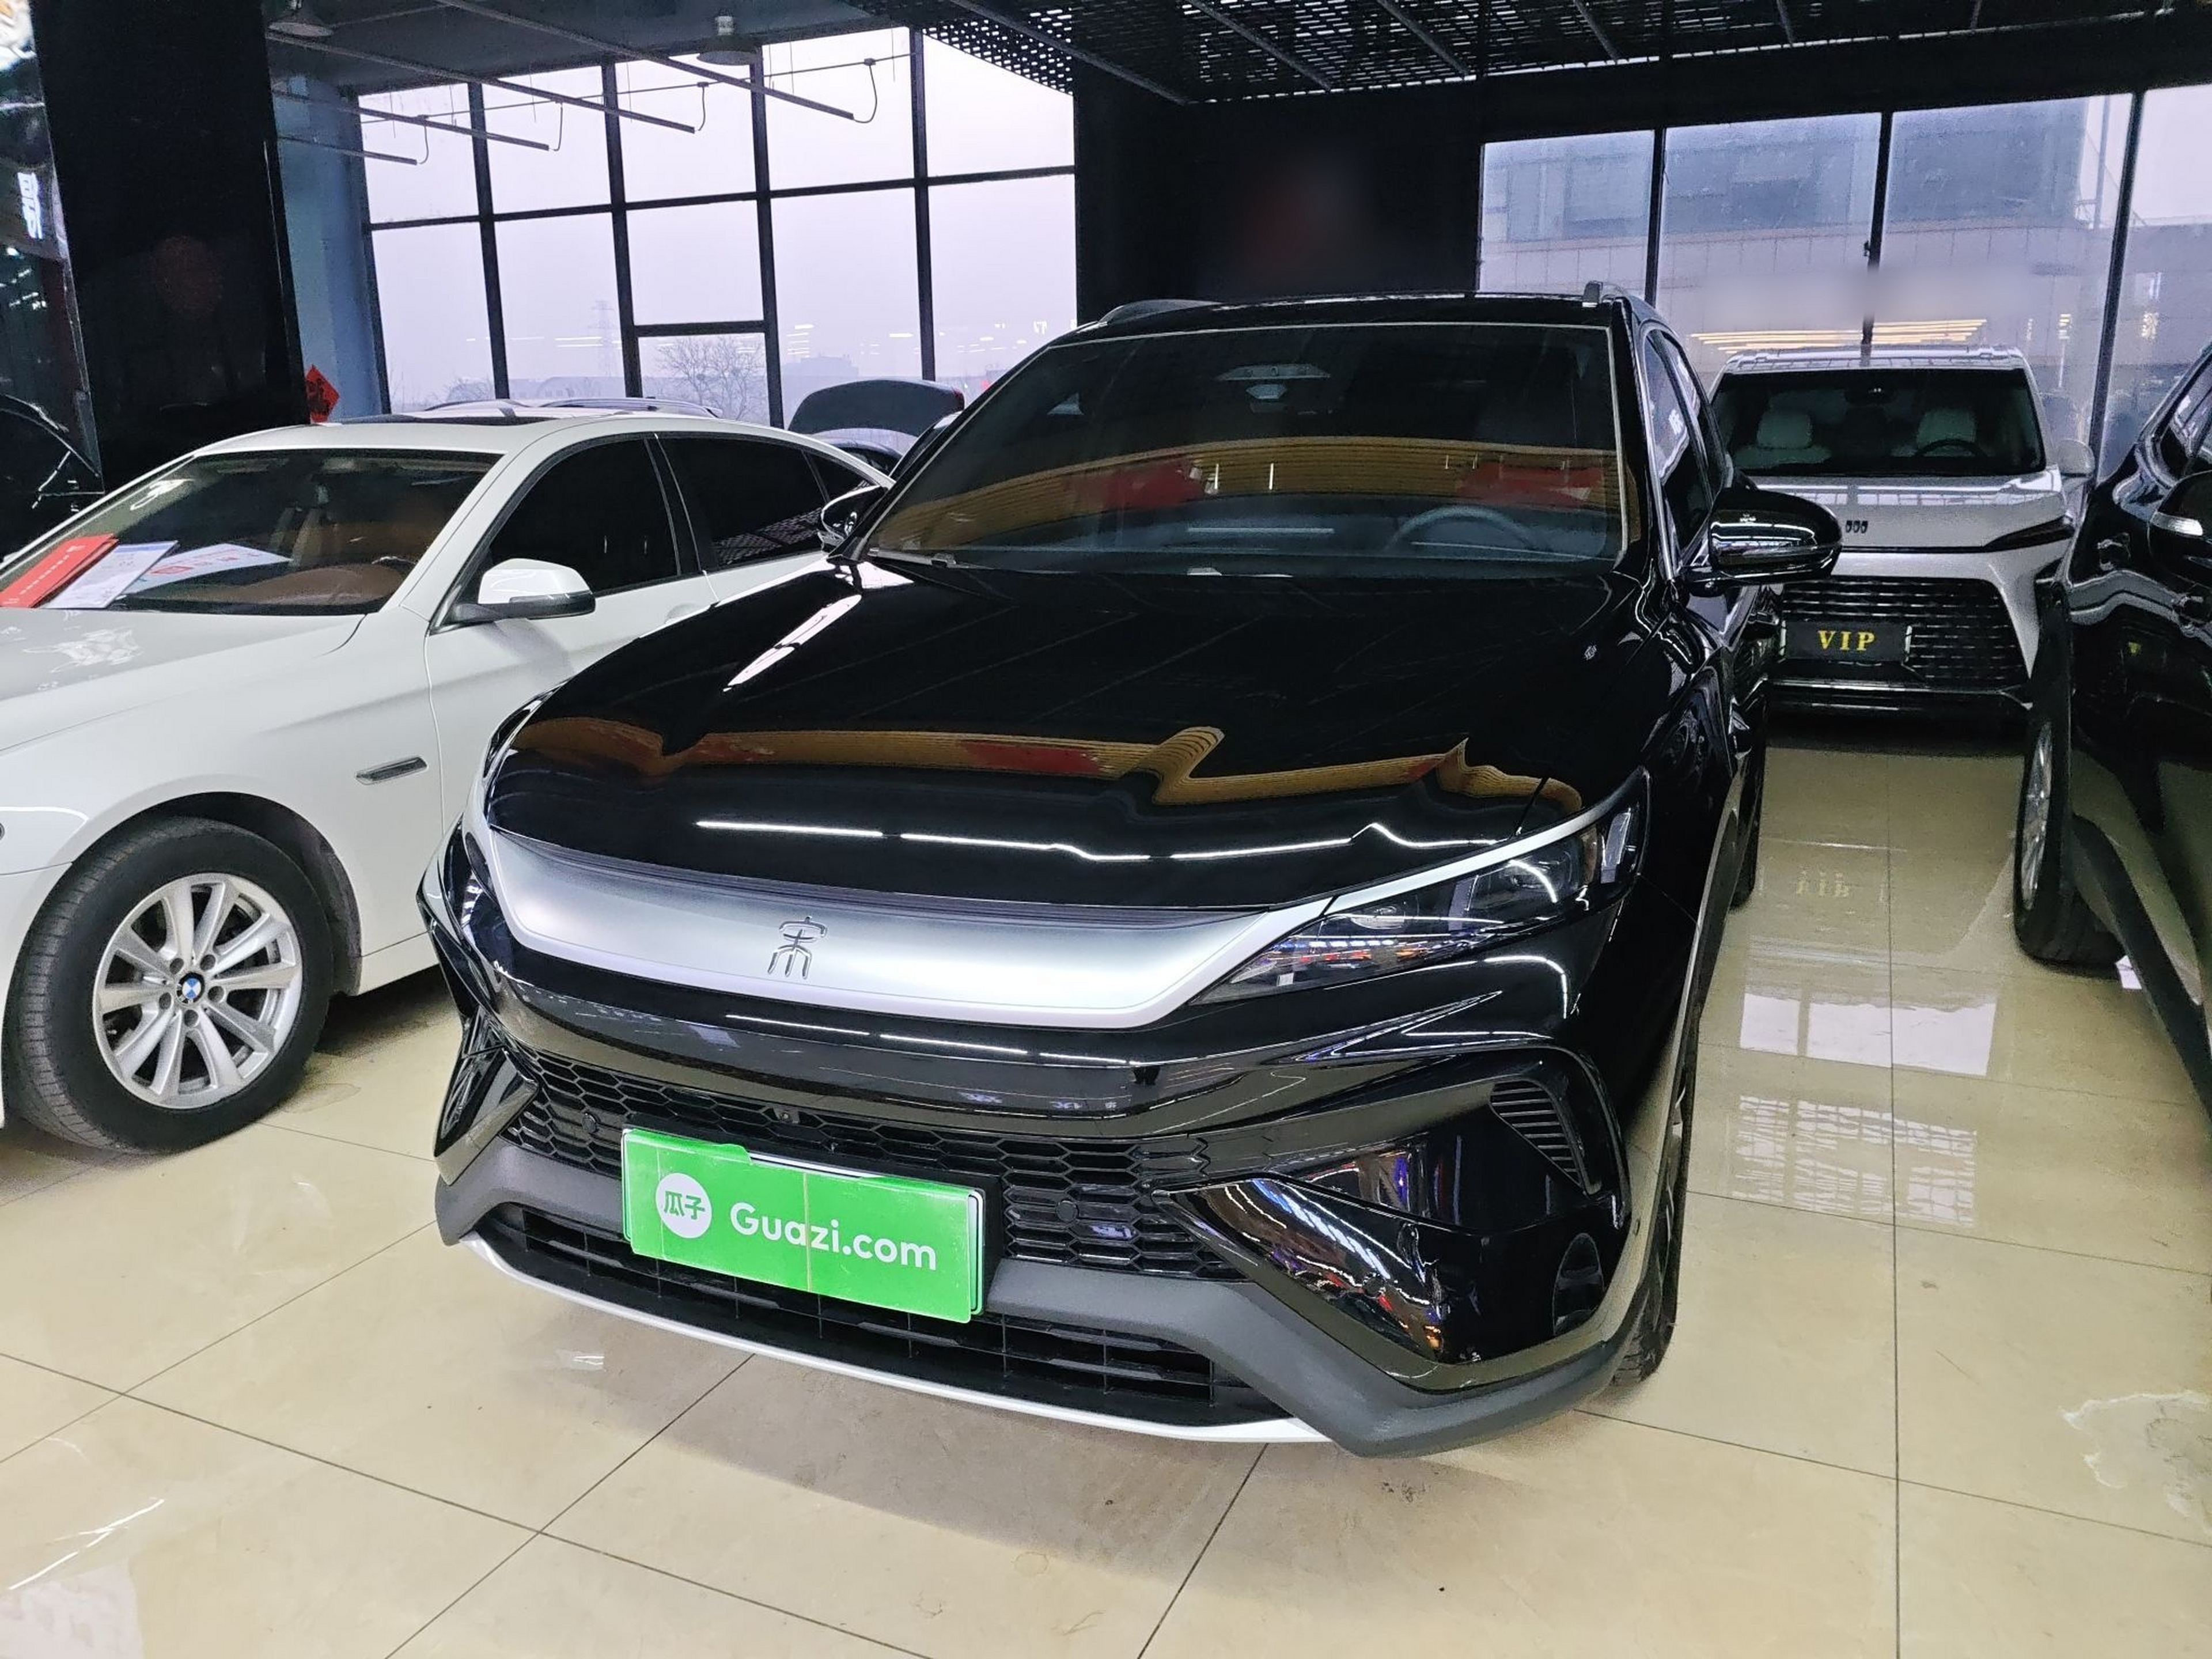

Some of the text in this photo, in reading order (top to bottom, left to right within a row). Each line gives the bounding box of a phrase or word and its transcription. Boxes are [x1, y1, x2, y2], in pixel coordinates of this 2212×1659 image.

[1817, 630, 1875, 651] VIP
[664, 1190, 706, 1220] 瓜子
[729, 1201, 937, 1271] Guazi.com
